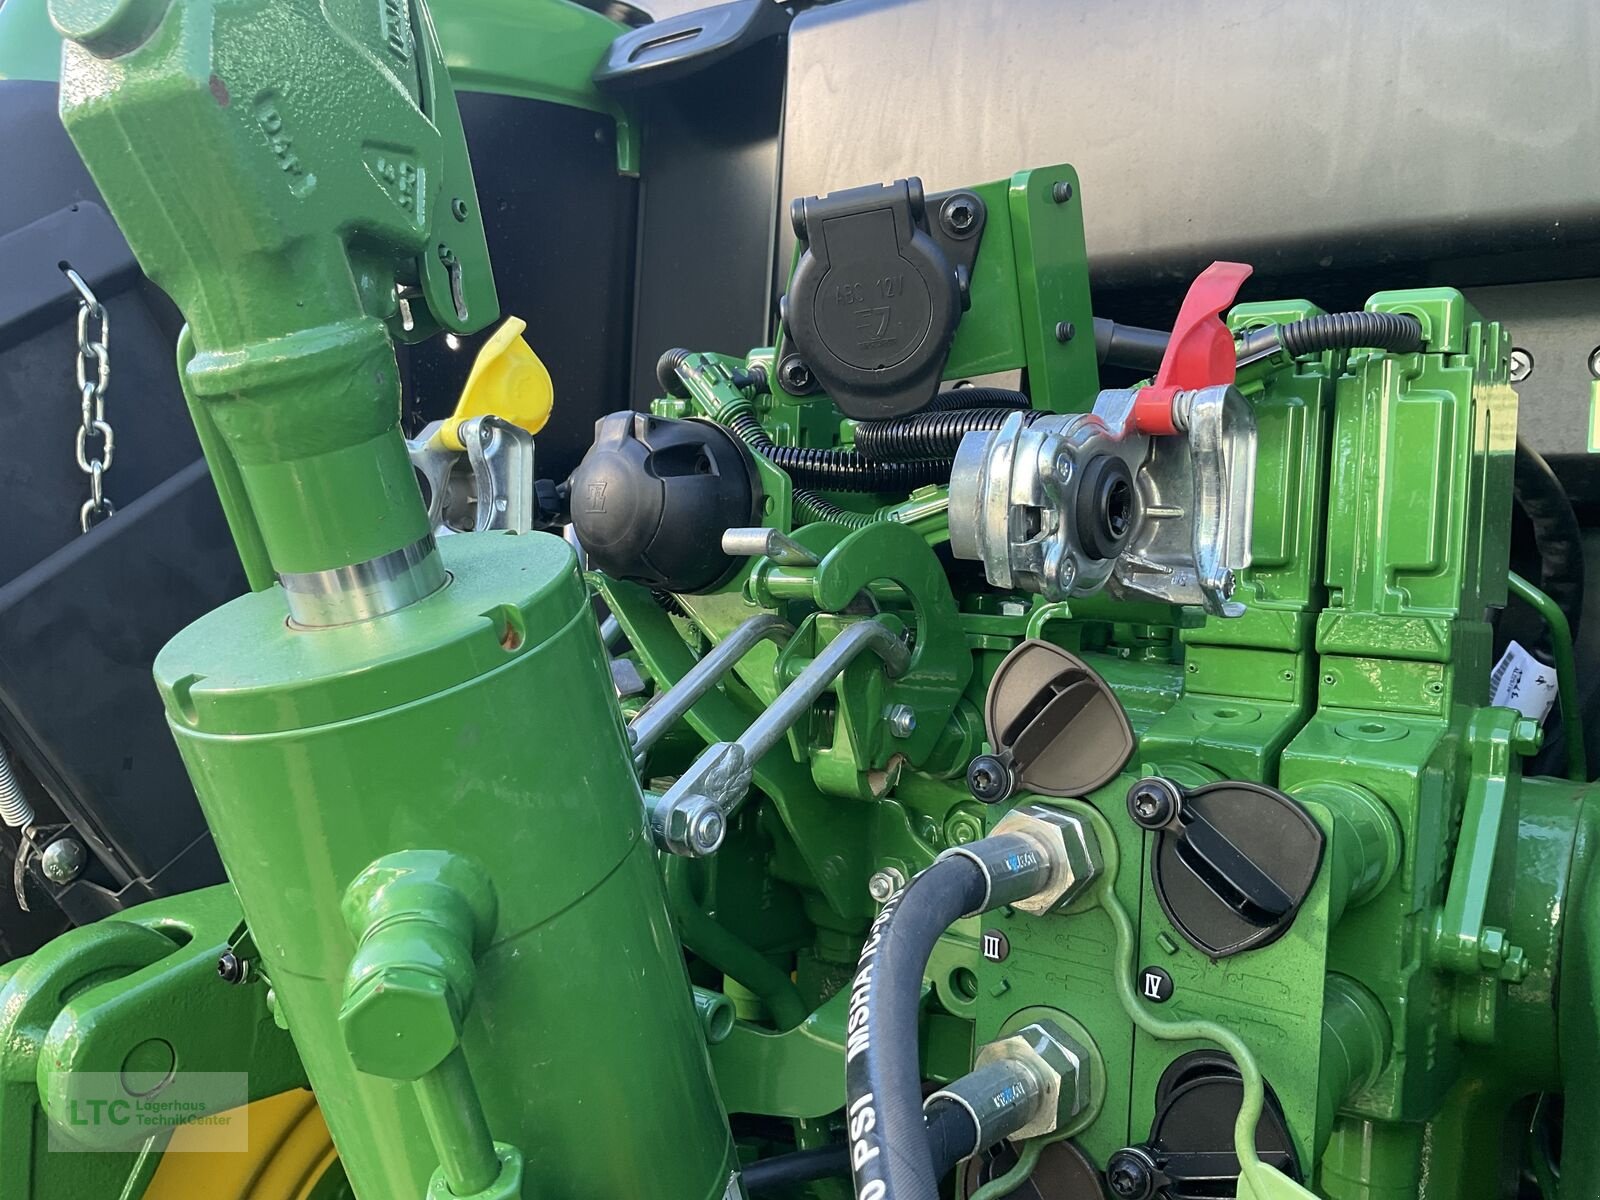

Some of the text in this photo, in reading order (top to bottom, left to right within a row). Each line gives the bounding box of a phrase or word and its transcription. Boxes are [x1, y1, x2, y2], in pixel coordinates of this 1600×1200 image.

[847, 963, 874, 1064] MSHA
[1144, 973, 1162, 999] IV
[850, 1092, 880, 1172] PSI
